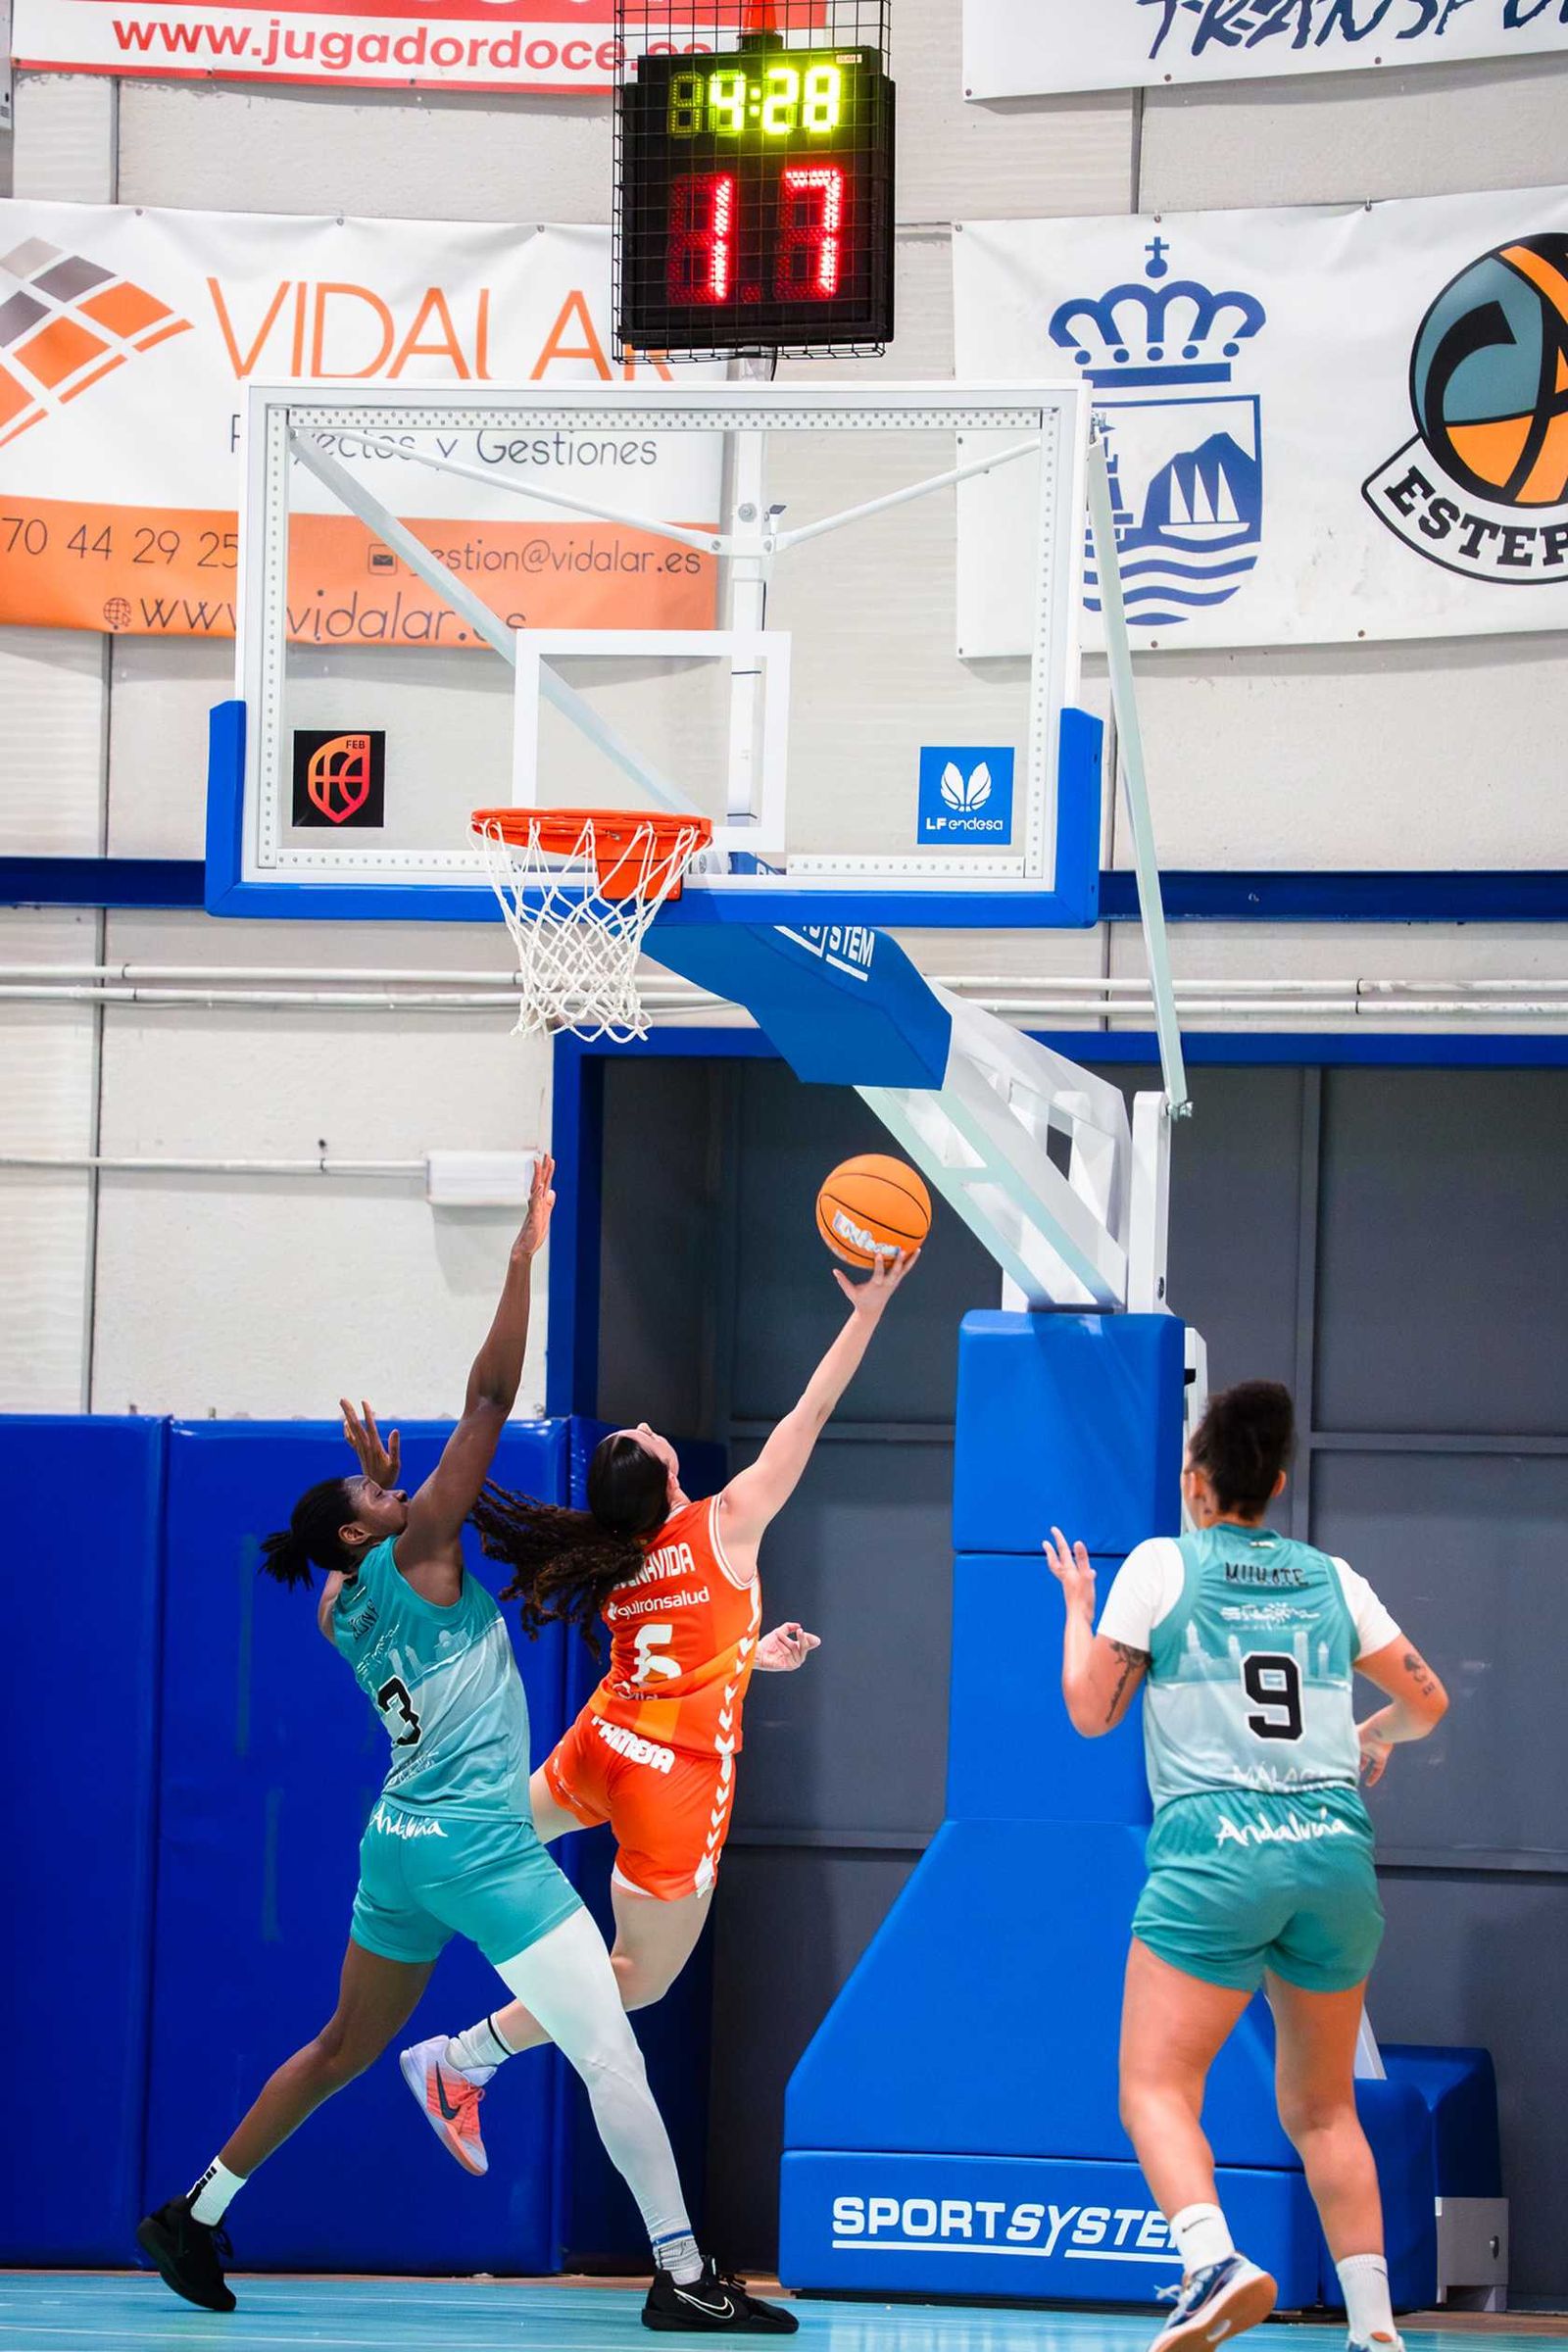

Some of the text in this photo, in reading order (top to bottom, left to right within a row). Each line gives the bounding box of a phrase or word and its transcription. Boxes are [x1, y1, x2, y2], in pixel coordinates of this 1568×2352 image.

[1137, 0, 1568, 59] TRANSP
[708, 64, 843, 136] 4:28
[476, 429, 658, 466] Gestiones
[2, 517, 238, 568] 70 44 29 25
[410, 539, 702, 576] estion@vidalar.es
[346, 740, 366, 750] FEB
[925, 817, 947, 830] LF
[631, 1624, 682, 1688] 6
[376, 1675, 422, 1746] 3
[1241, 1651, 1302, 1743] 9
[832, 2196, 1177, 2252] SPORTSYSTE
